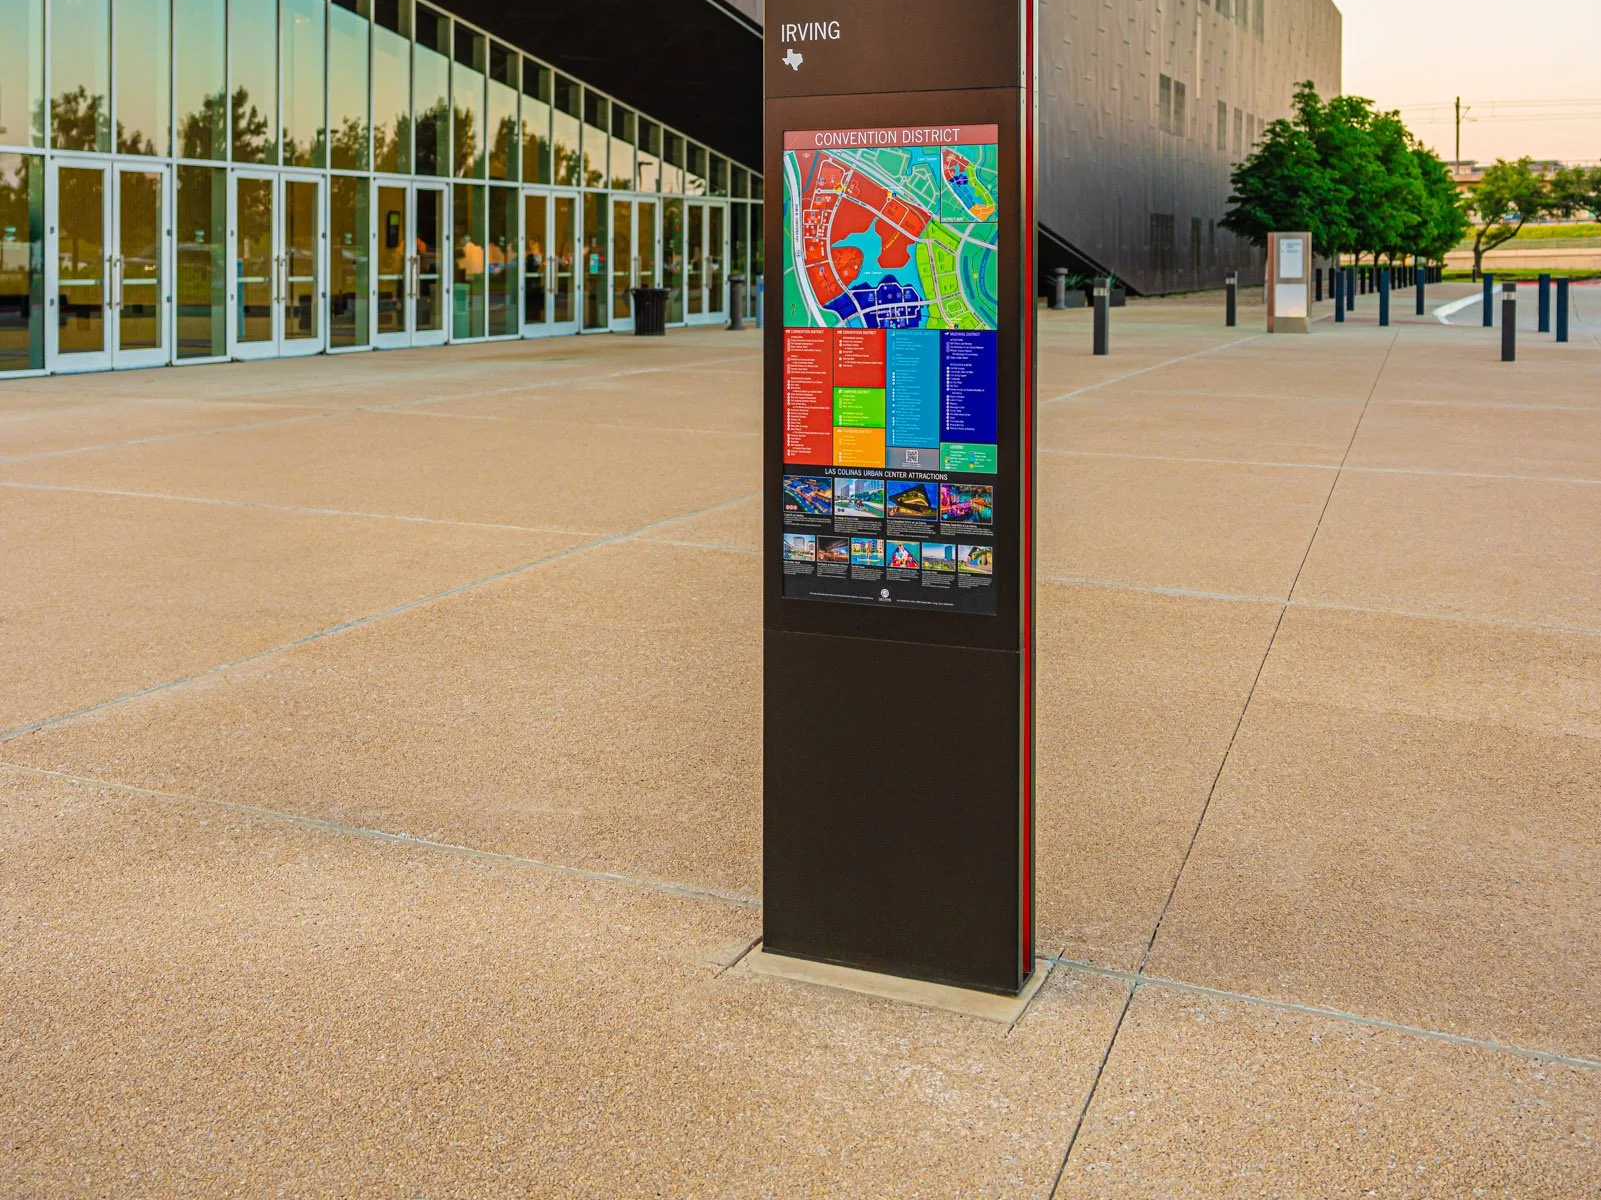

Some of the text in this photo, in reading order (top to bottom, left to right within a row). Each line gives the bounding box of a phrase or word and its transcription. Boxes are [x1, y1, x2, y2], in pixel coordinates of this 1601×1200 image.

[781, 20, 841, 43] IRVING
[815, 128, 961, 146] CONVENTION DISTRICT
[837, 469, 862, 477] COLINAS
[884, 471, 907, 479] CENTER
[908, 472, 948, 481] ATTRACTIONS
